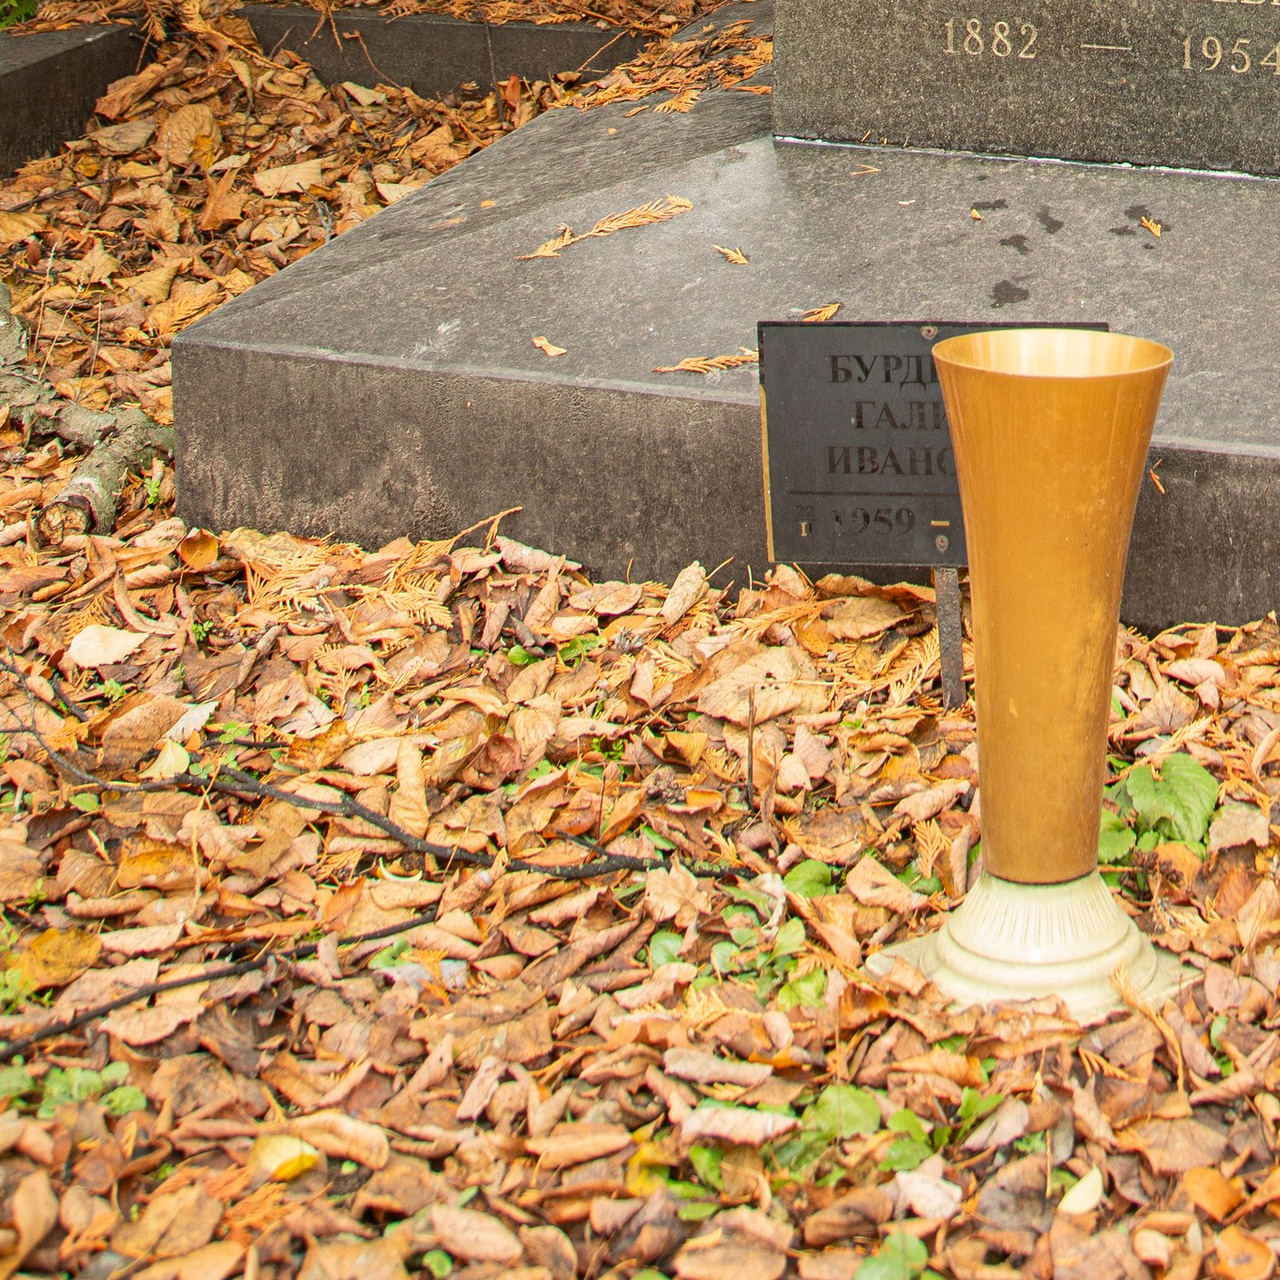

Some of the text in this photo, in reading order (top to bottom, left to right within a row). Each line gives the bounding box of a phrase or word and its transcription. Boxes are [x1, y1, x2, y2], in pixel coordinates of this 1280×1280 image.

[945, 20, 1038, 59] 1882
[854, 401, 950, 430] ГАЛИ
[827, 446, 957, 476] ИВАНО
[831, 507, 917, 536] 1959
